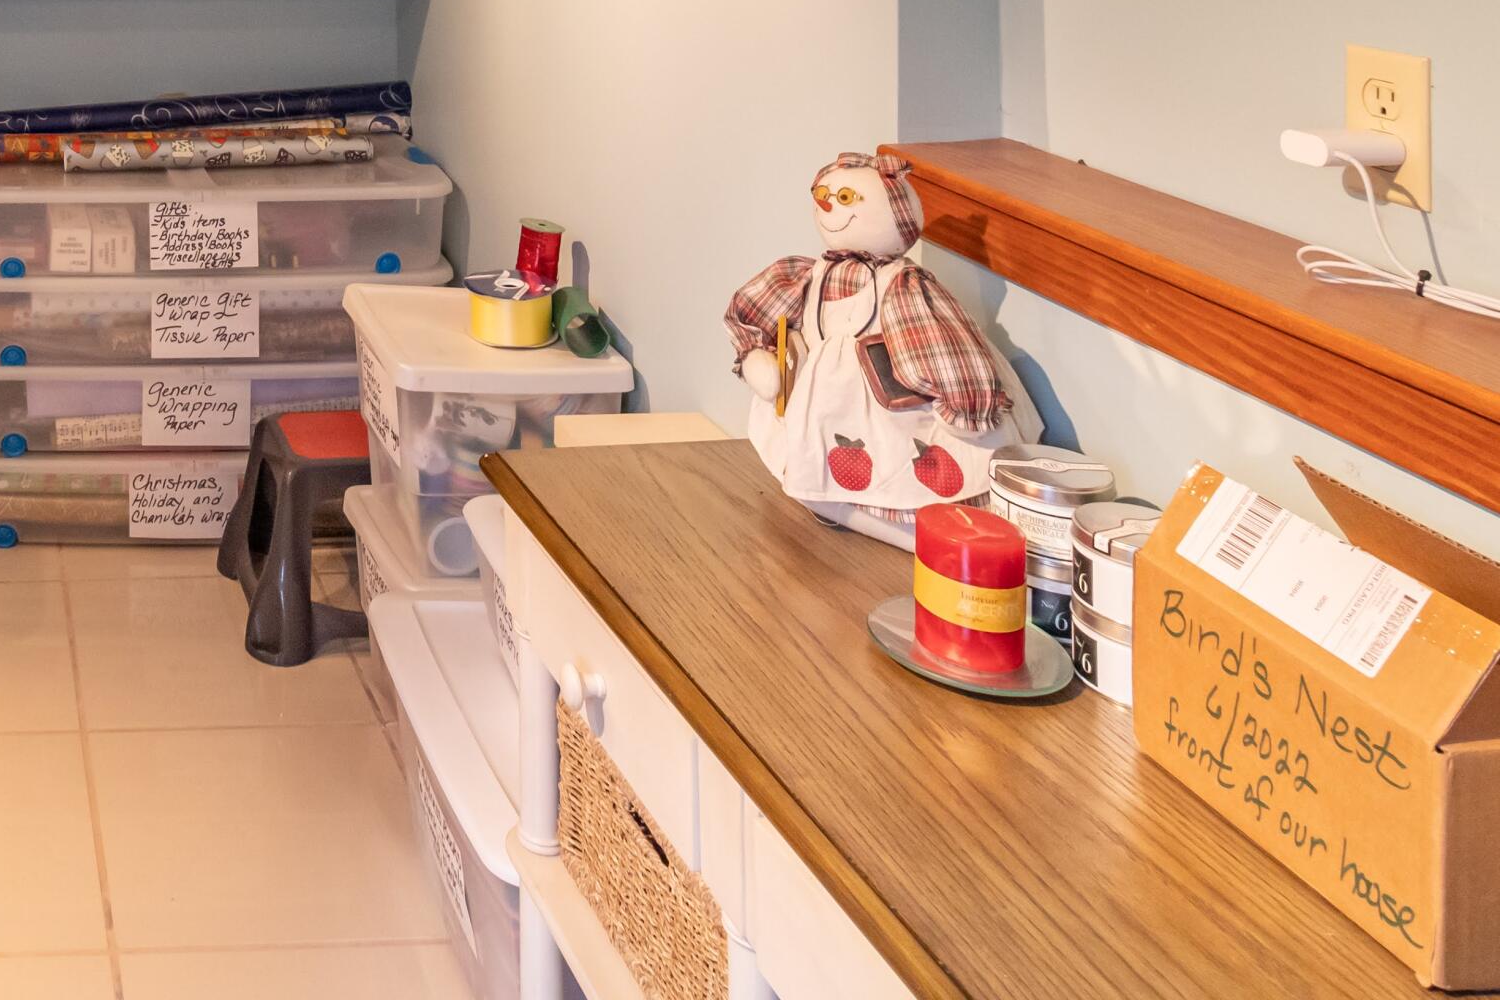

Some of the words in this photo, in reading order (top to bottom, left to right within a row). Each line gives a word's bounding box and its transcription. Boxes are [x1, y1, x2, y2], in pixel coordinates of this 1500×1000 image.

[193, 215, 226, 228] items
[160, 230, 212, 246] Birthday
[216, 228, 250, 241] Books
[161, 241, 203, 252] Address
[208, 240, 242, 251] Books
[200, 260, 234, 269] items
[155, 325, 208, 343] Tissue
[213, 326, 254, 351] Paper
[164, 414, 205, 434] Paper
[132, 473, 222, 492] Christmas,
[193, 492, 223, 506] and
[131, 509, 194, 526] Chanukah
[1079, 572, 1088, 594] 6
[1054, 611, 1069, 632] 6
[1082, 652, 1092, 674] 6
[1159, 589, 1272, 701] Bird's
[1295, 674, 1412, 790] Nest
[1164, 696, 1236, 790] front
[1243, 775, 1275, 822] of
[1279, 811, 1328, 857] our
